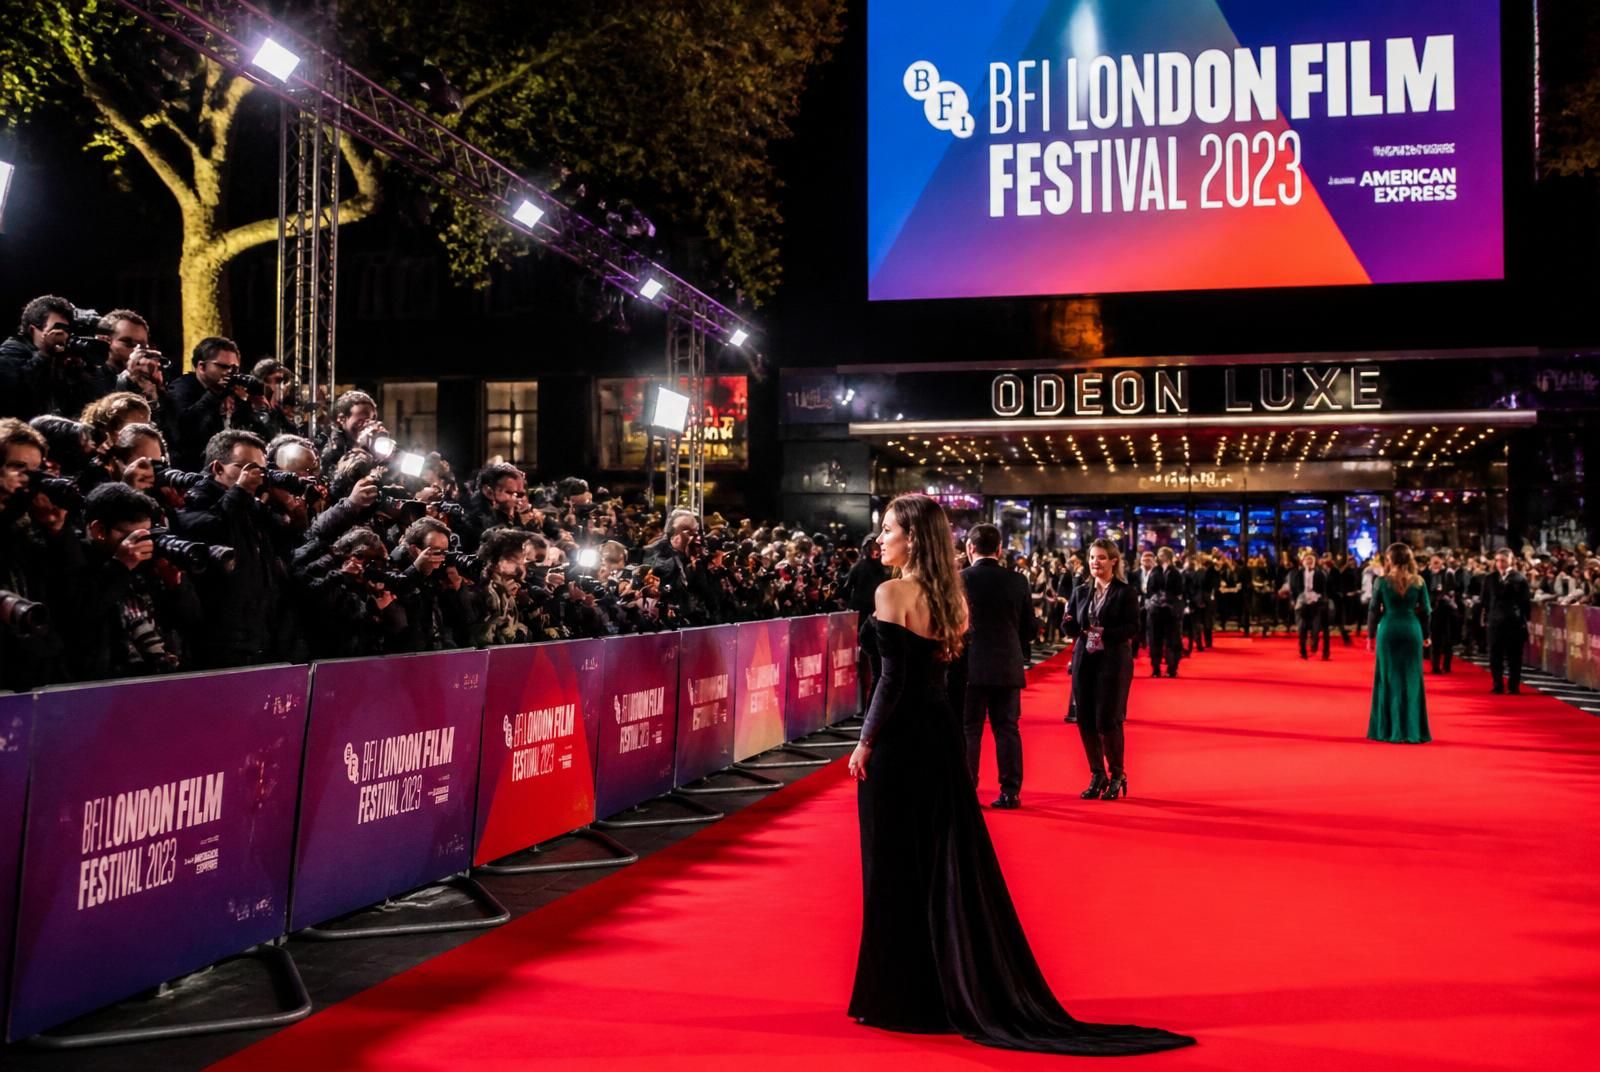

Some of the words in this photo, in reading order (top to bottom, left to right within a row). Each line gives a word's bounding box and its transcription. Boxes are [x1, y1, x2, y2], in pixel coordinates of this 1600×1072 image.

[989, 59, 1050, 135] BFI
[1067, 46, 1277, 131] LONDON
[1290, 34, 1455, 120] FILM
[989, 136, 1188, 218] FESTIVAL
[1199, 130, 1303, 209] 2023
[1359, 167, 1457, 188] AMERICAN
[1374, 184, 1458, 203] EXPRESS
[991, 370, 1189, 417] ODEON
[1225, 366, 1383, 412] LUXE
[362, 740, 378, 782] BFI
[378, 731, 424, 779] LONDON
[422, 726, 455, 769] FILM
[81, 797, 105, 855] BFI
[104, 782, 177, 849] LONDON
[176, 771, 225, 831] FILM
[358, 779, 400, 824] FESTIVAL
[77, 846, 143, 911] FESTIVAL
[145, 837, 177, 890] 2023
